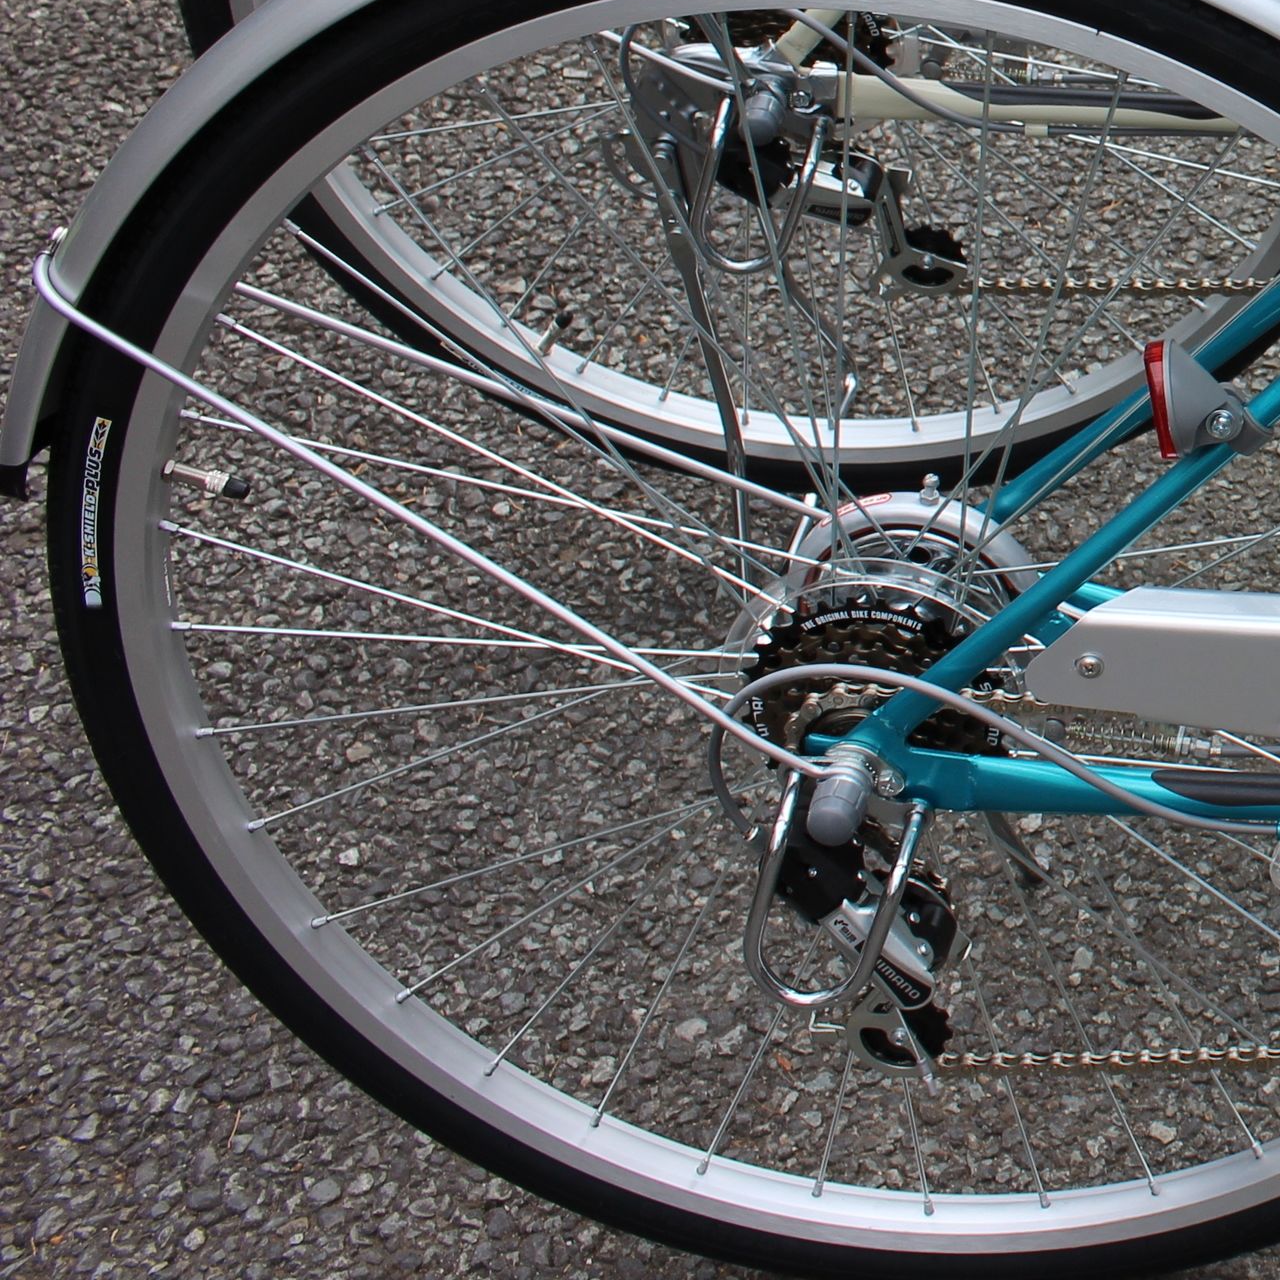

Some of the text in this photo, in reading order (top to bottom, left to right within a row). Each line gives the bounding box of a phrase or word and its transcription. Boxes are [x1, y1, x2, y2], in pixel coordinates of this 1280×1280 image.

[84, 447, 103, 492] PLUS
[801, 610, 923, 633] THE ORIGINAL BIKE COMPONENTS
[877, 958, 922, 1001] IMANO
